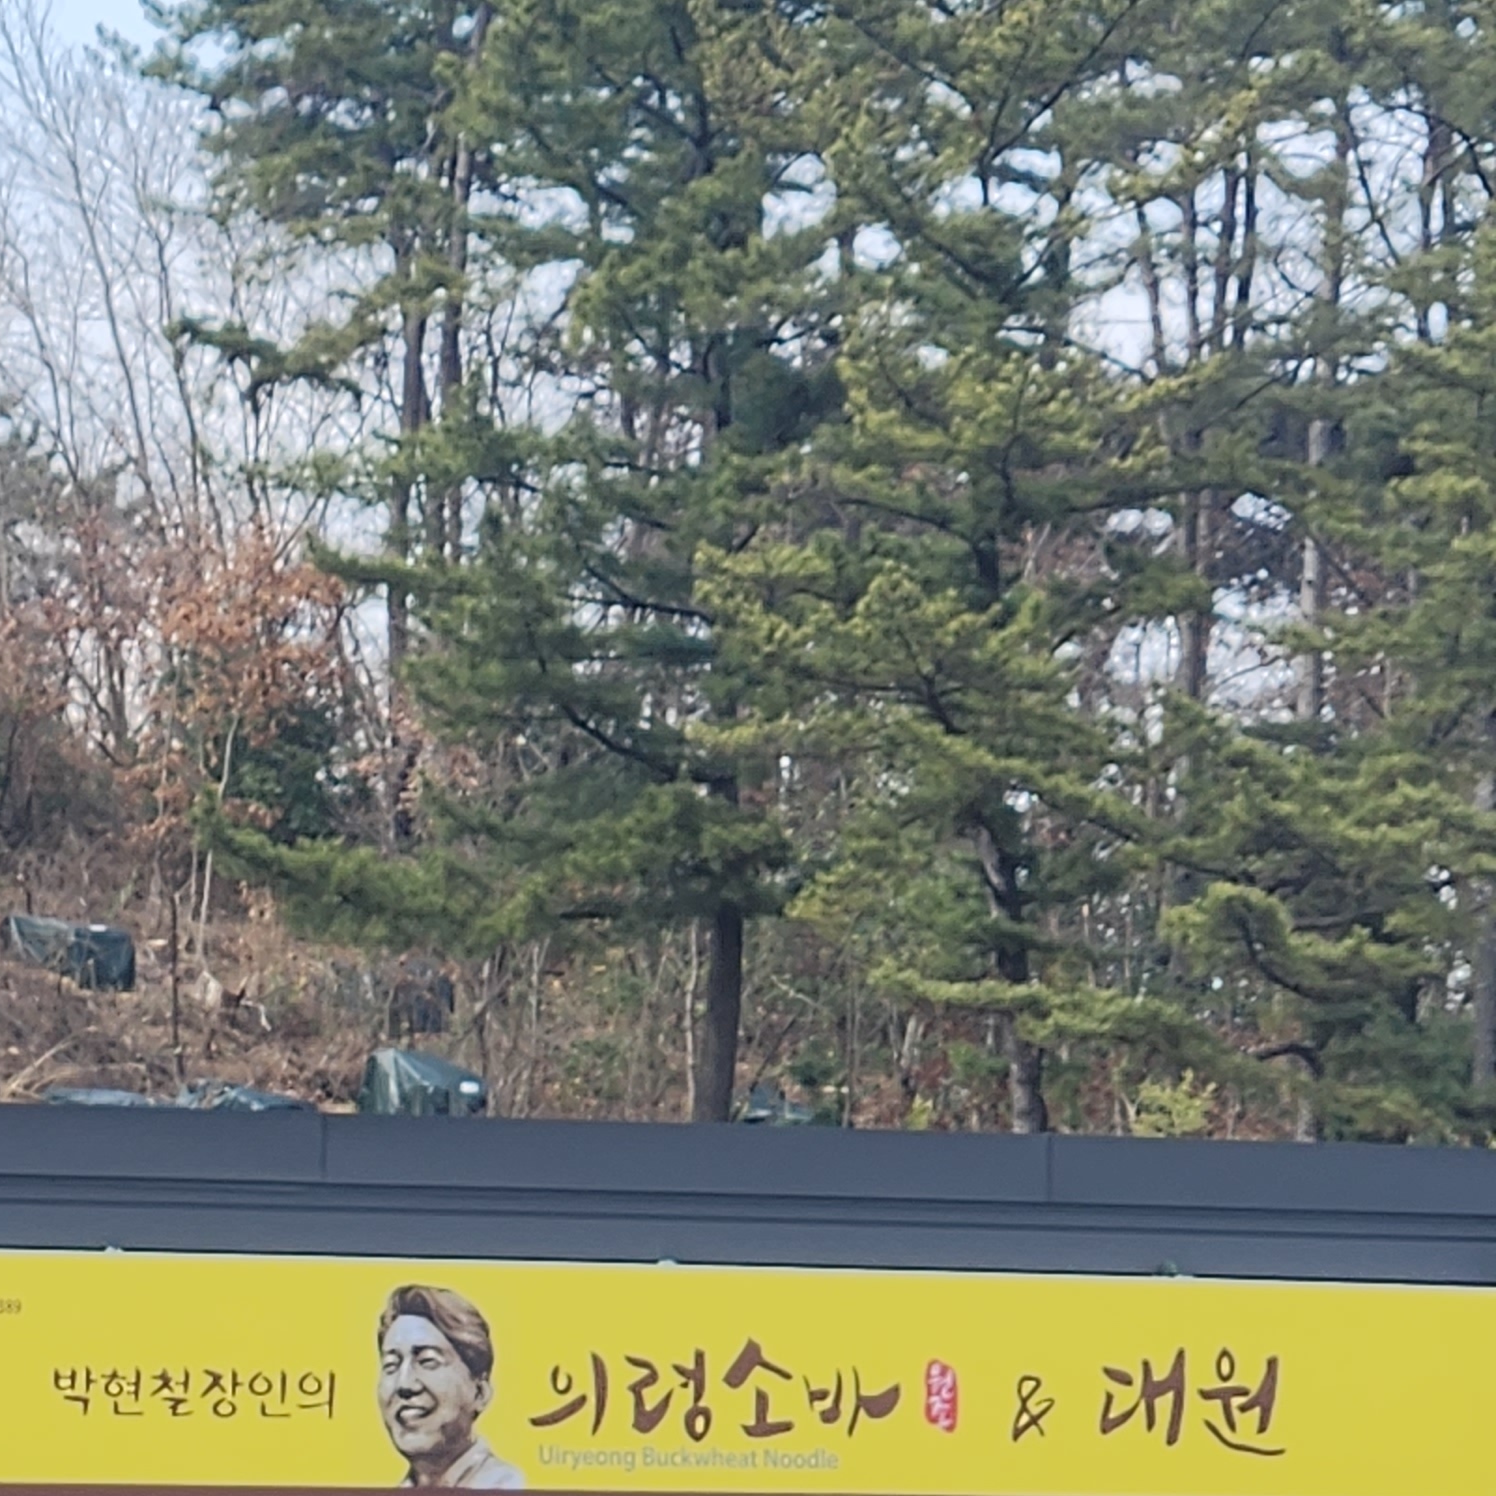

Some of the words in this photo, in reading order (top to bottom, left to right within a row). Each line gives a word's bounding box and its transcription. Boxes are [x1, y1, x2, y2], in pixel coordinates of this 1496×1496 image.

[53, 1366, 335, 1419] 박현철장인의
[528, 1337, 901, 1442] 의령소바
[1012, 1375, 1055, 1442] &
[1100, 1347, 1286, 1456] 대원
[539, 1445, 636, 1471] Uiryeong
[643, 1447, 758, 1469] Buckwheat
[764, 1449, 839, 1470] Noodle
